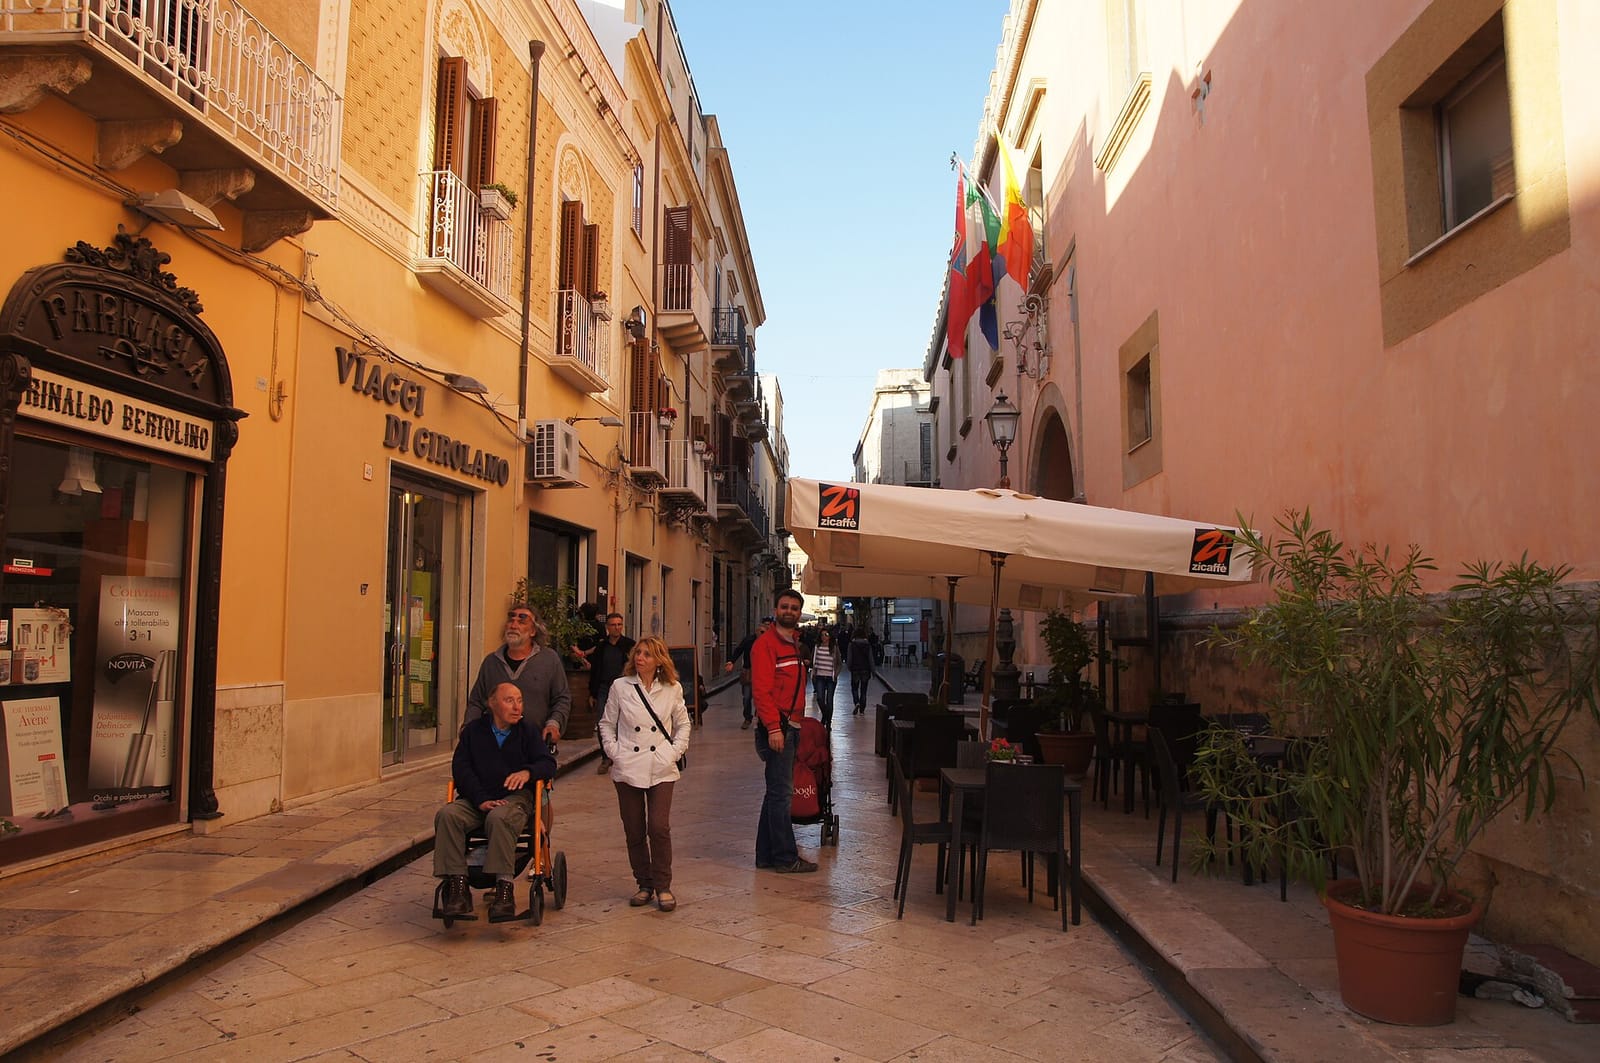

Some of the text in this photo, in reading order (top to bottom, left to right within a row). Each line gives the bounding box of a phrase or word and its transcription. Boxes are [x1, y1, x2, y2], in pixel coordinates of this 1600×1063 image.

[335, 346, 426, 417] VIAGGI
[24, 377, 210, 451] RINALDO BERTOLINO
[383, 413, 510, 487] DI GIROLAMO
[127, 608, 160, 617] Mascara
[129, 629, 137, 641] 3
[108, 658, 147, 670] NOVITÀ
[18, 712, 49, 728] Avène
[793, 784, 816, 799] oogle
